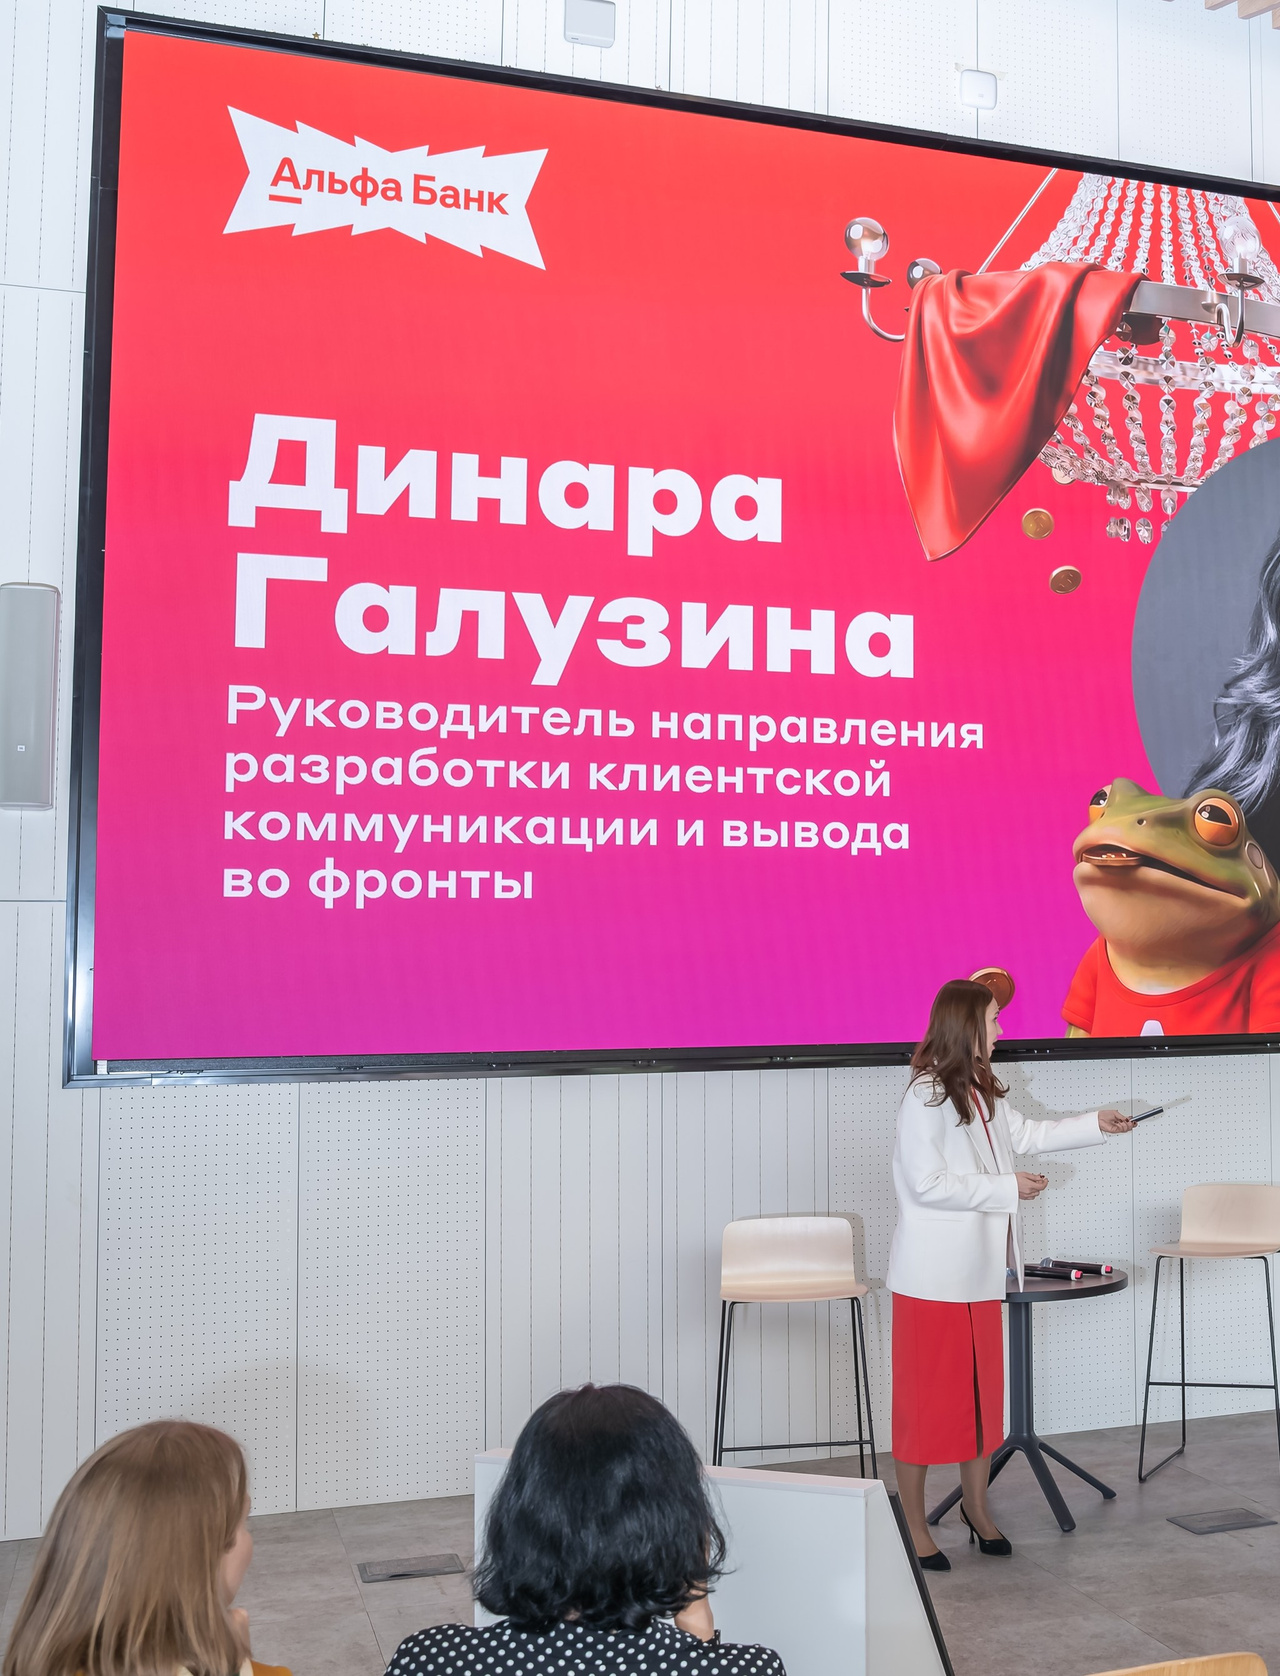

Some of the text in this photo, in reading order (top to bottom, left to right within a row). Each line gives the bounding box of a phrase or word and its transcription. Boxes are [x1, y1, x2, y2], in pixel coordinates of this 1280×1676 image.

[269, 157, 508, 215] Альфа Банк
[228, 414, 783, 557] Динара
[235, 553, 914, 685] Галузина
[228, 685, 984, 752] Руководитель направления
[225, 746, 890, 797] разработки клиентской
[224, 811, 909, 856] коммуникации и вывода
[223, 858, 532, 909] во фронты
